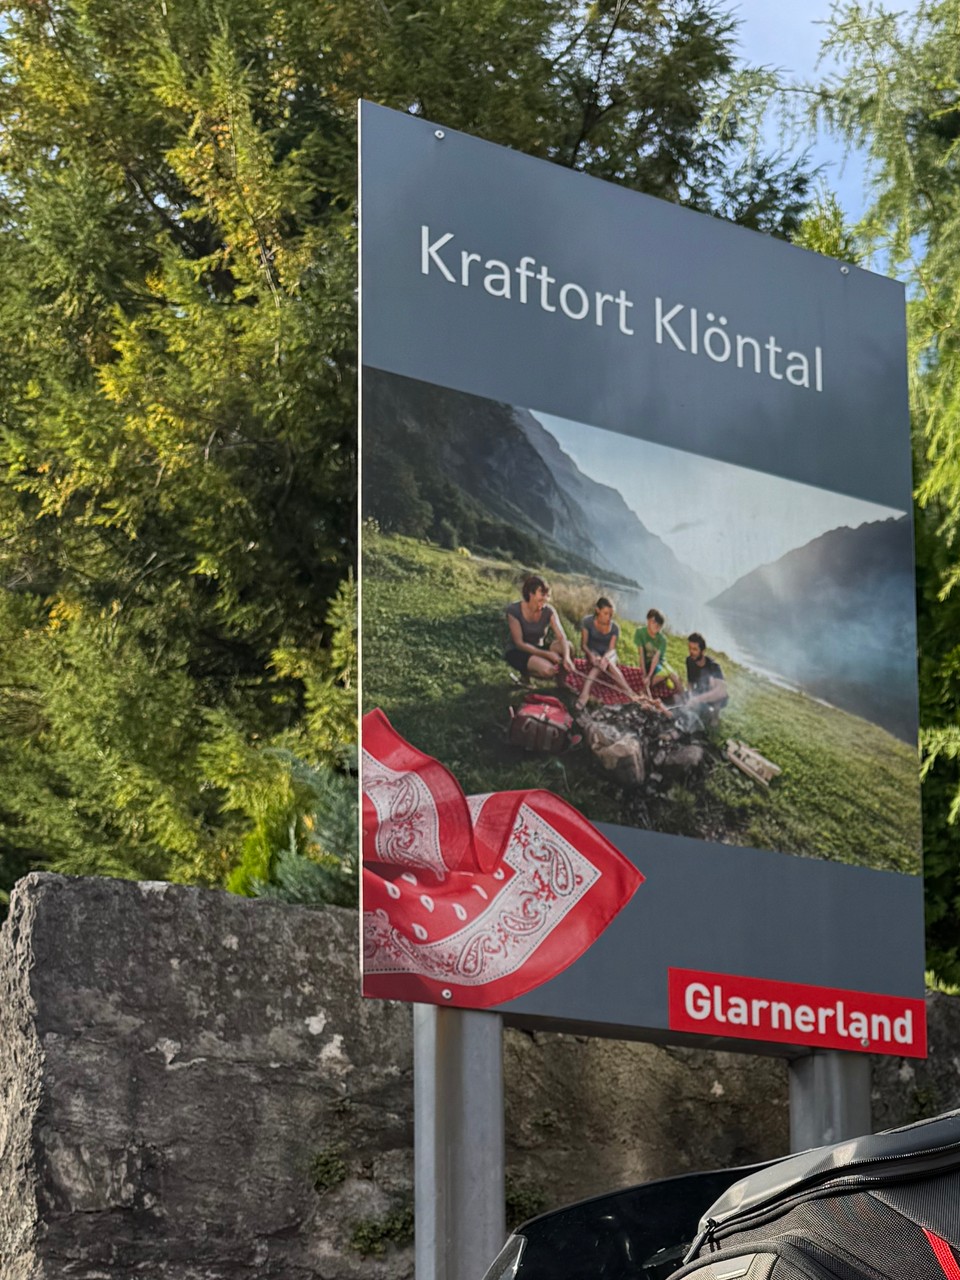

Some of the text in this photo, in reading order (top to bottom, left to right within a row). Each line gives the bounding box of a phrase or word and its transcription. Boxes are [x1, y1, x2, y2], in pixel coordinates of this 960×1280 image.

[420, 224, 824, 393] Kraftort Klöntal
[684, 981, 914, 1045] Glarnerland
